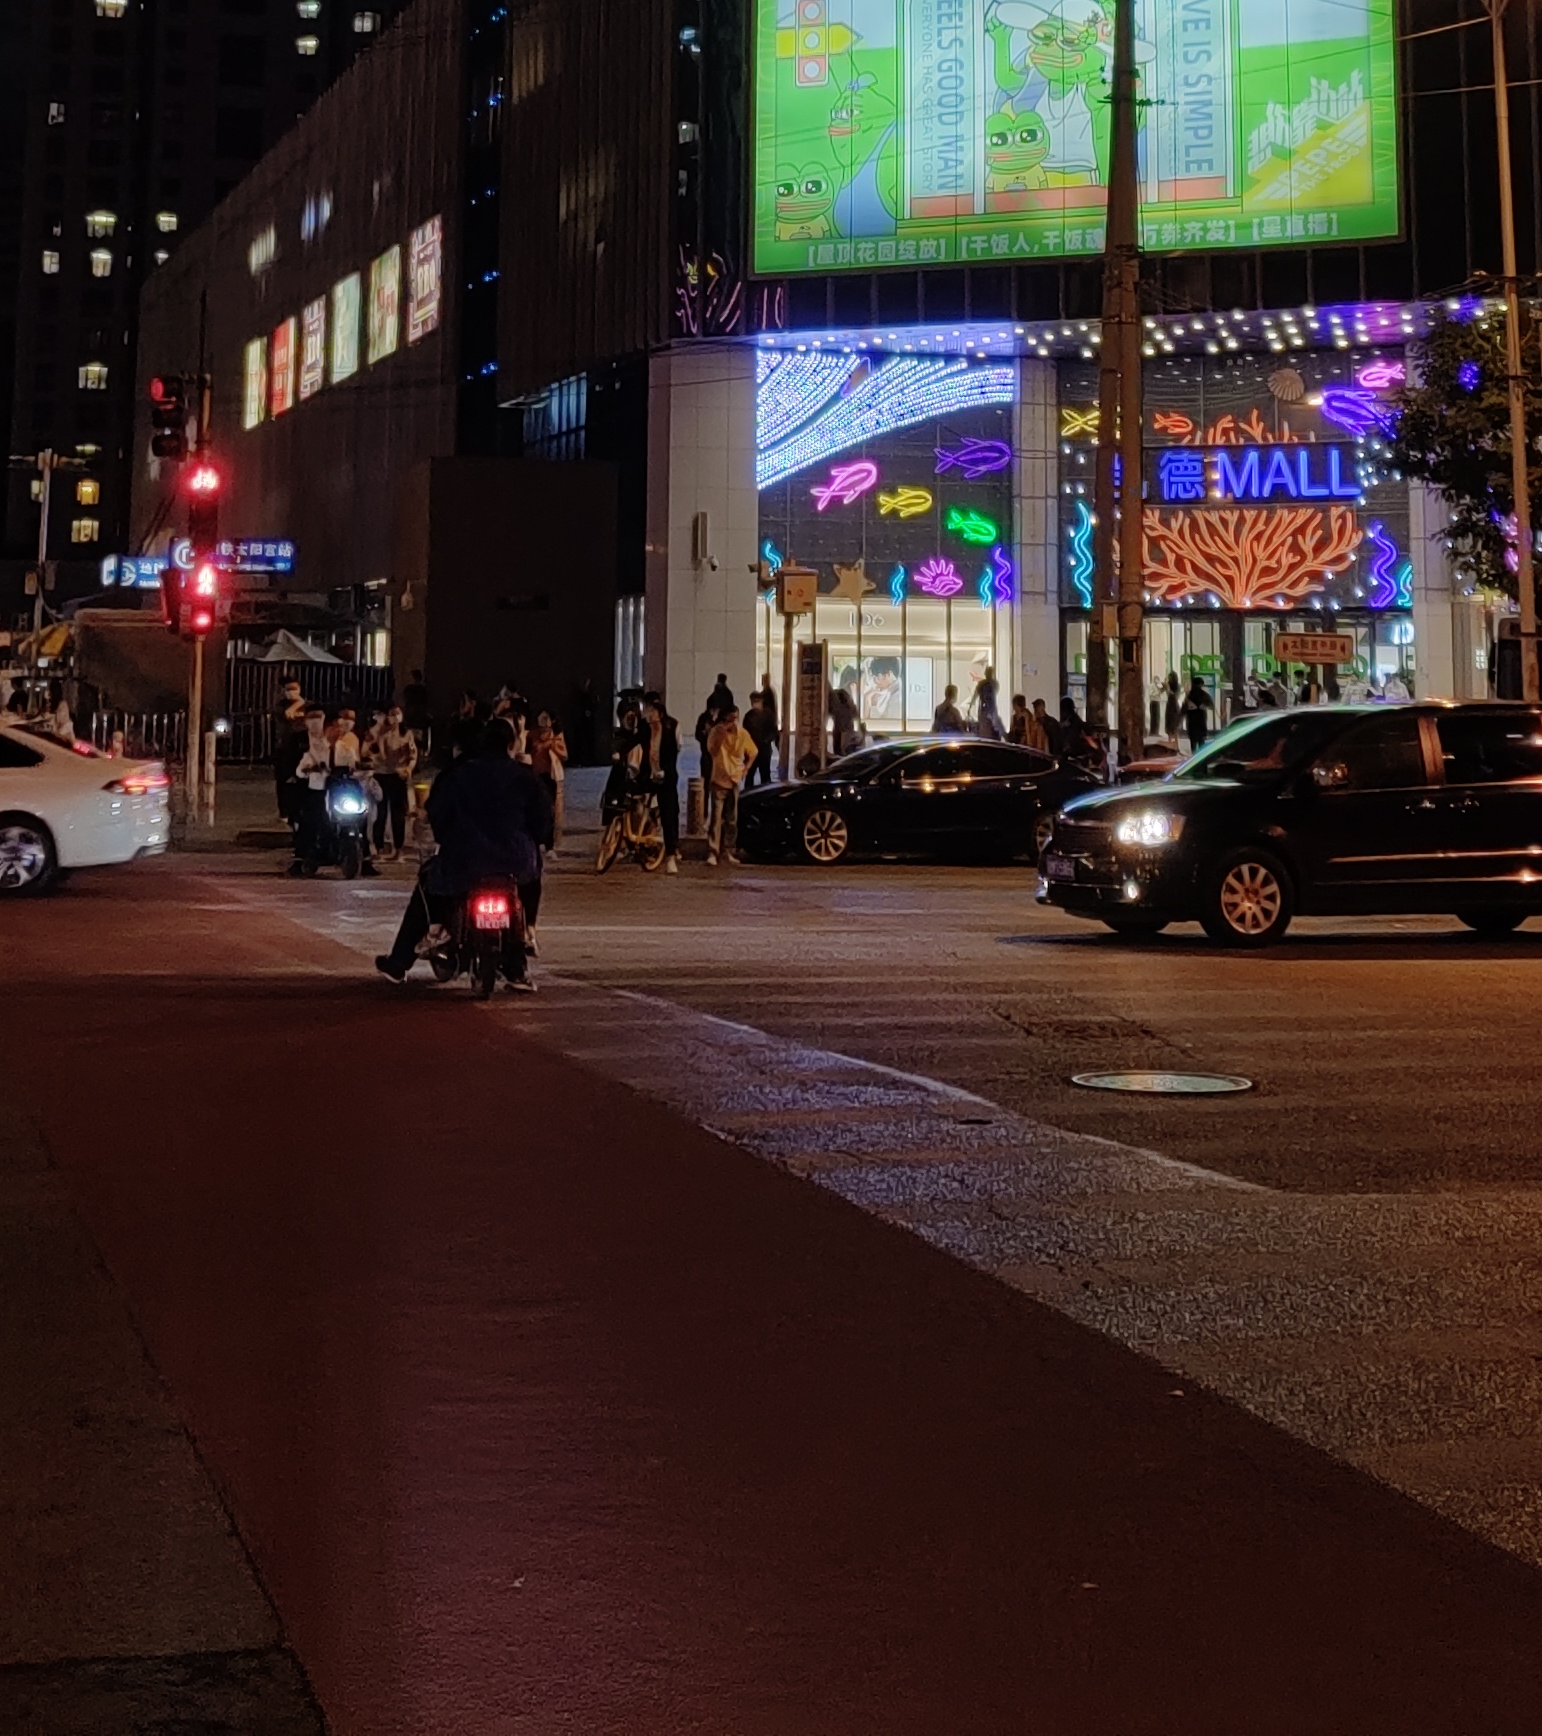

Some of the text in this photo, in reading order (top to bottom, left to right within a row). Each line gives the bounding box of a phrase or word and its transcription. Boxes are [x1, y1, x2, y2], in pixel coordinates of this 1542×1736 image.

[1182, 41, 1212, 65] IS
[922, 64, 934, 95] HAS
[937, 58, 965, 127] GOOD
[1183, 73, 1214, 174] SIMPLE
[937, 134, 965, 191] MAN
[1214, 448, 1361, 499] MALL
[216, 541, 292, 557] 铁太阳宫站
